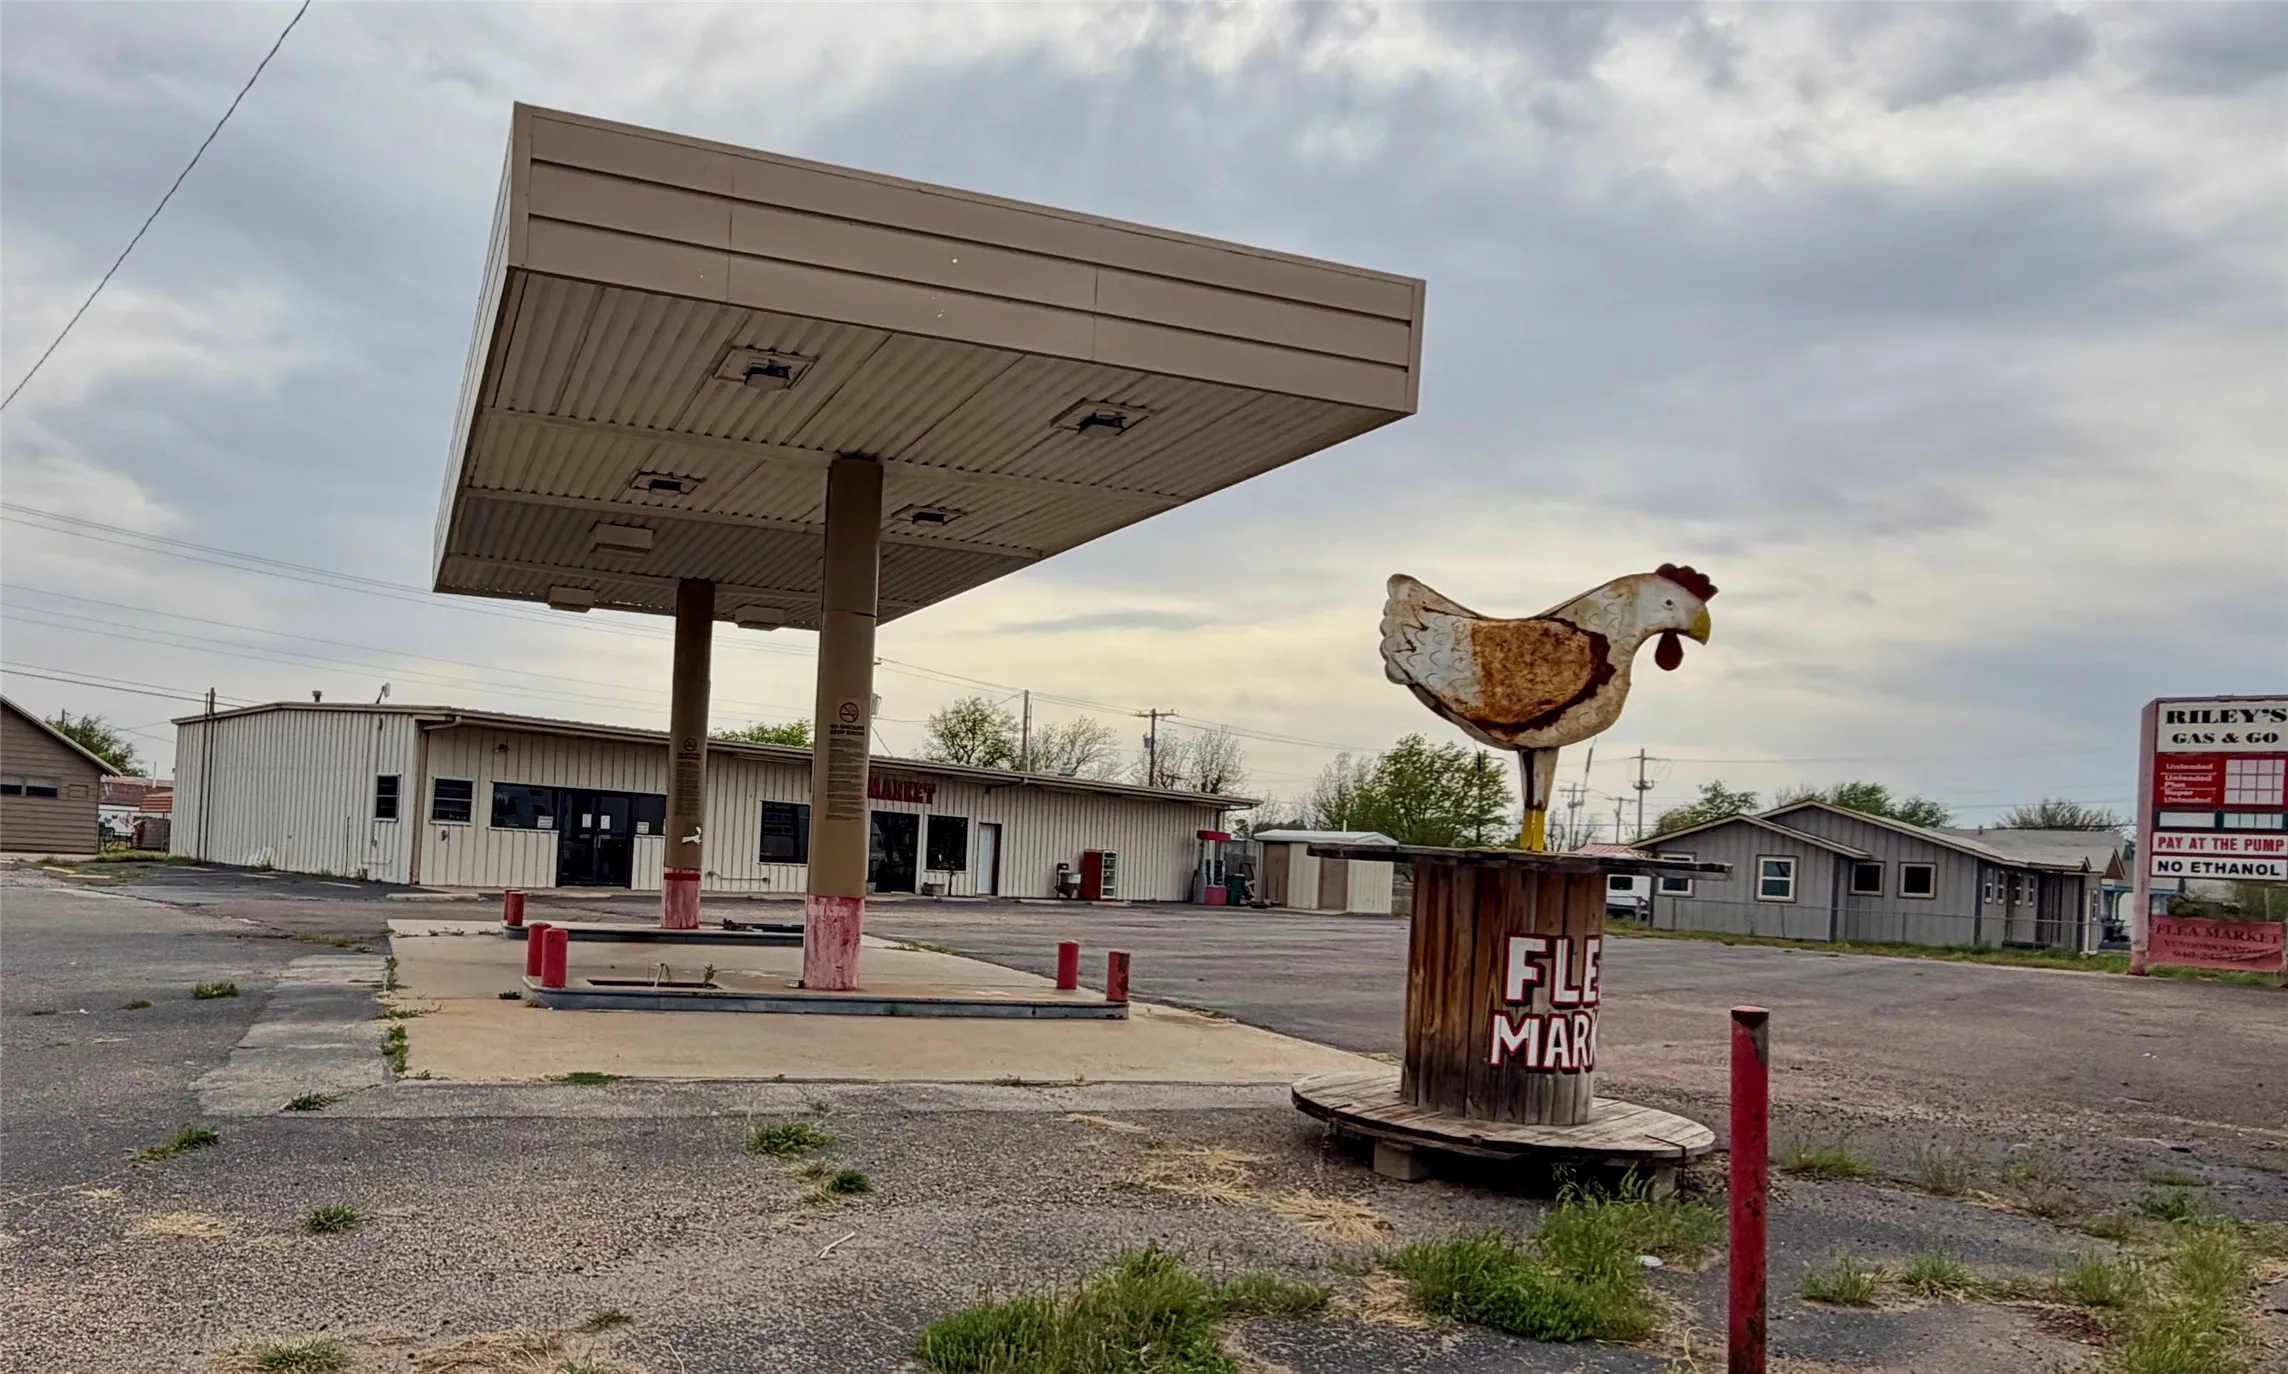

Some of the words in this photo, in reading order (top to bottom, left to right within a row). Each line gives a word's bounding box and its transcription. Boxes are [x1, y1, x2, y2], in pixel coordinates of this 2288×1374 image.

[2166, 708, 2287, 723] RILEY'S
[2172, 732, 2215, 744] GAS
[2221, 732, 2240, 744] &
[2246, 732, 2279, 744] GO
[867, 776, 936, 804] MARKET
[2158, 837, 2183, 849] PAY
[2189, 837, 2207, 850] AT
[2212, 838, 2238, 851] THE
[2244, 839, 2285, 852] PUMP
[2157, 860, 2183, 872] NO
[2190, 862, 2281, 876] ETHANOL
[2156, 924, 2199, 937] FLEA
[2204, 927, 2279, 944] MARKET
[1504, 934, 1601, 1008] FLE
